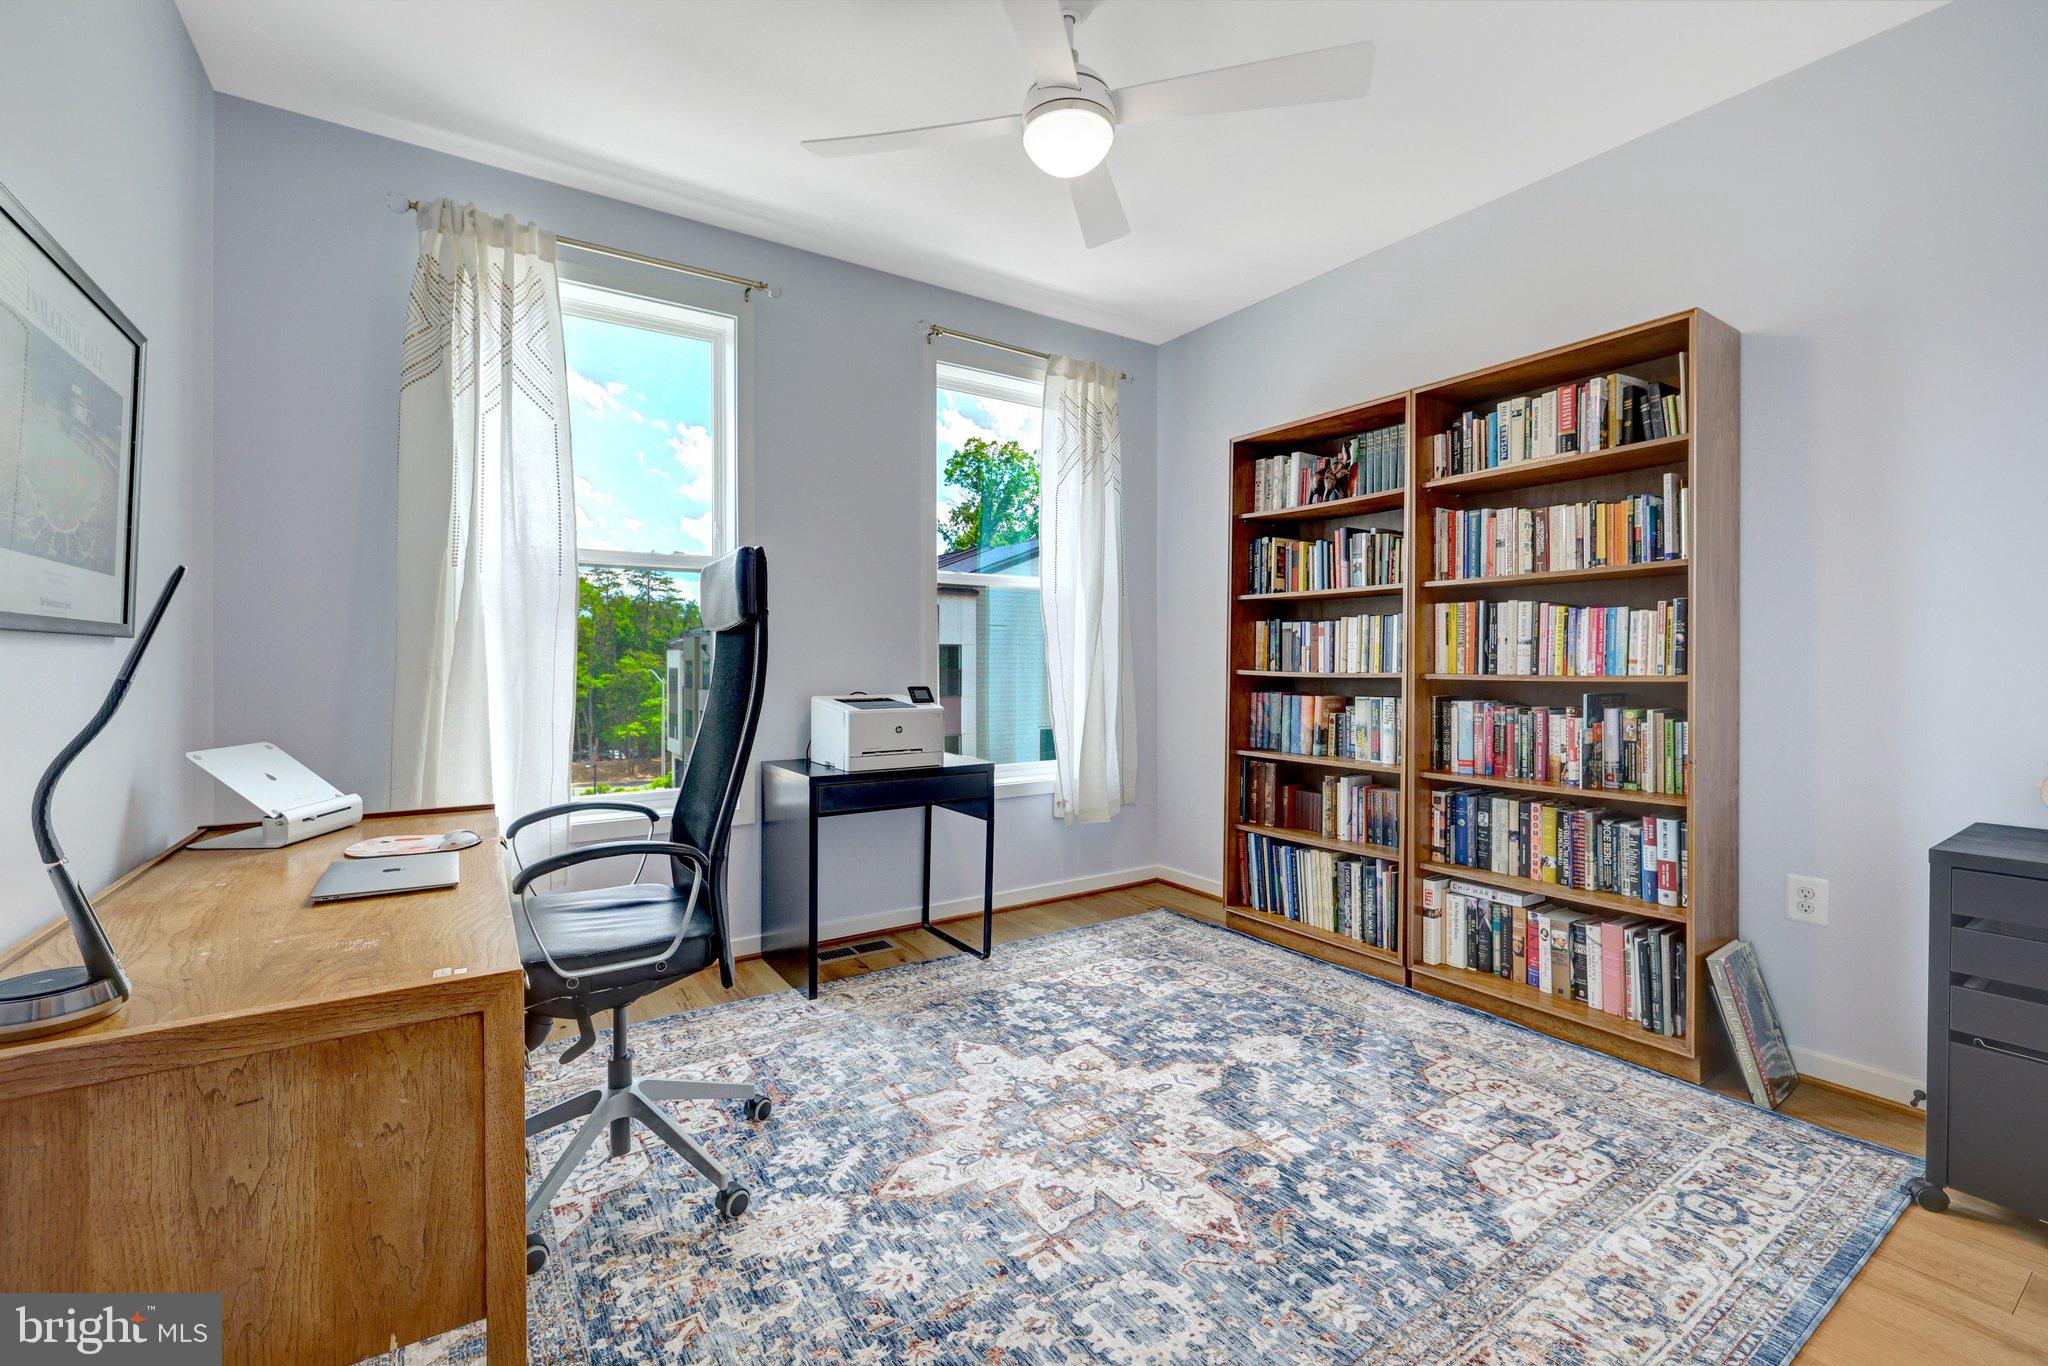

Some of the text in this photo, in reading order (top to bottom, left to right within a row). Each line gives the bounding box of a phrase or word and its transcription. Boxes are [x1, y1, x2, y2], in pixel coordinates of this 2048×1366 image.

[1562, 388, 1572, 429] WASHINGTON
[1603, 821, 1612, 865] MOE BERG
[1425, 889, 1433, 906] LIFE
[1452, 882, 1490, 896] CHIP WAR
[1723, 996, 1735, 1014] LOST
